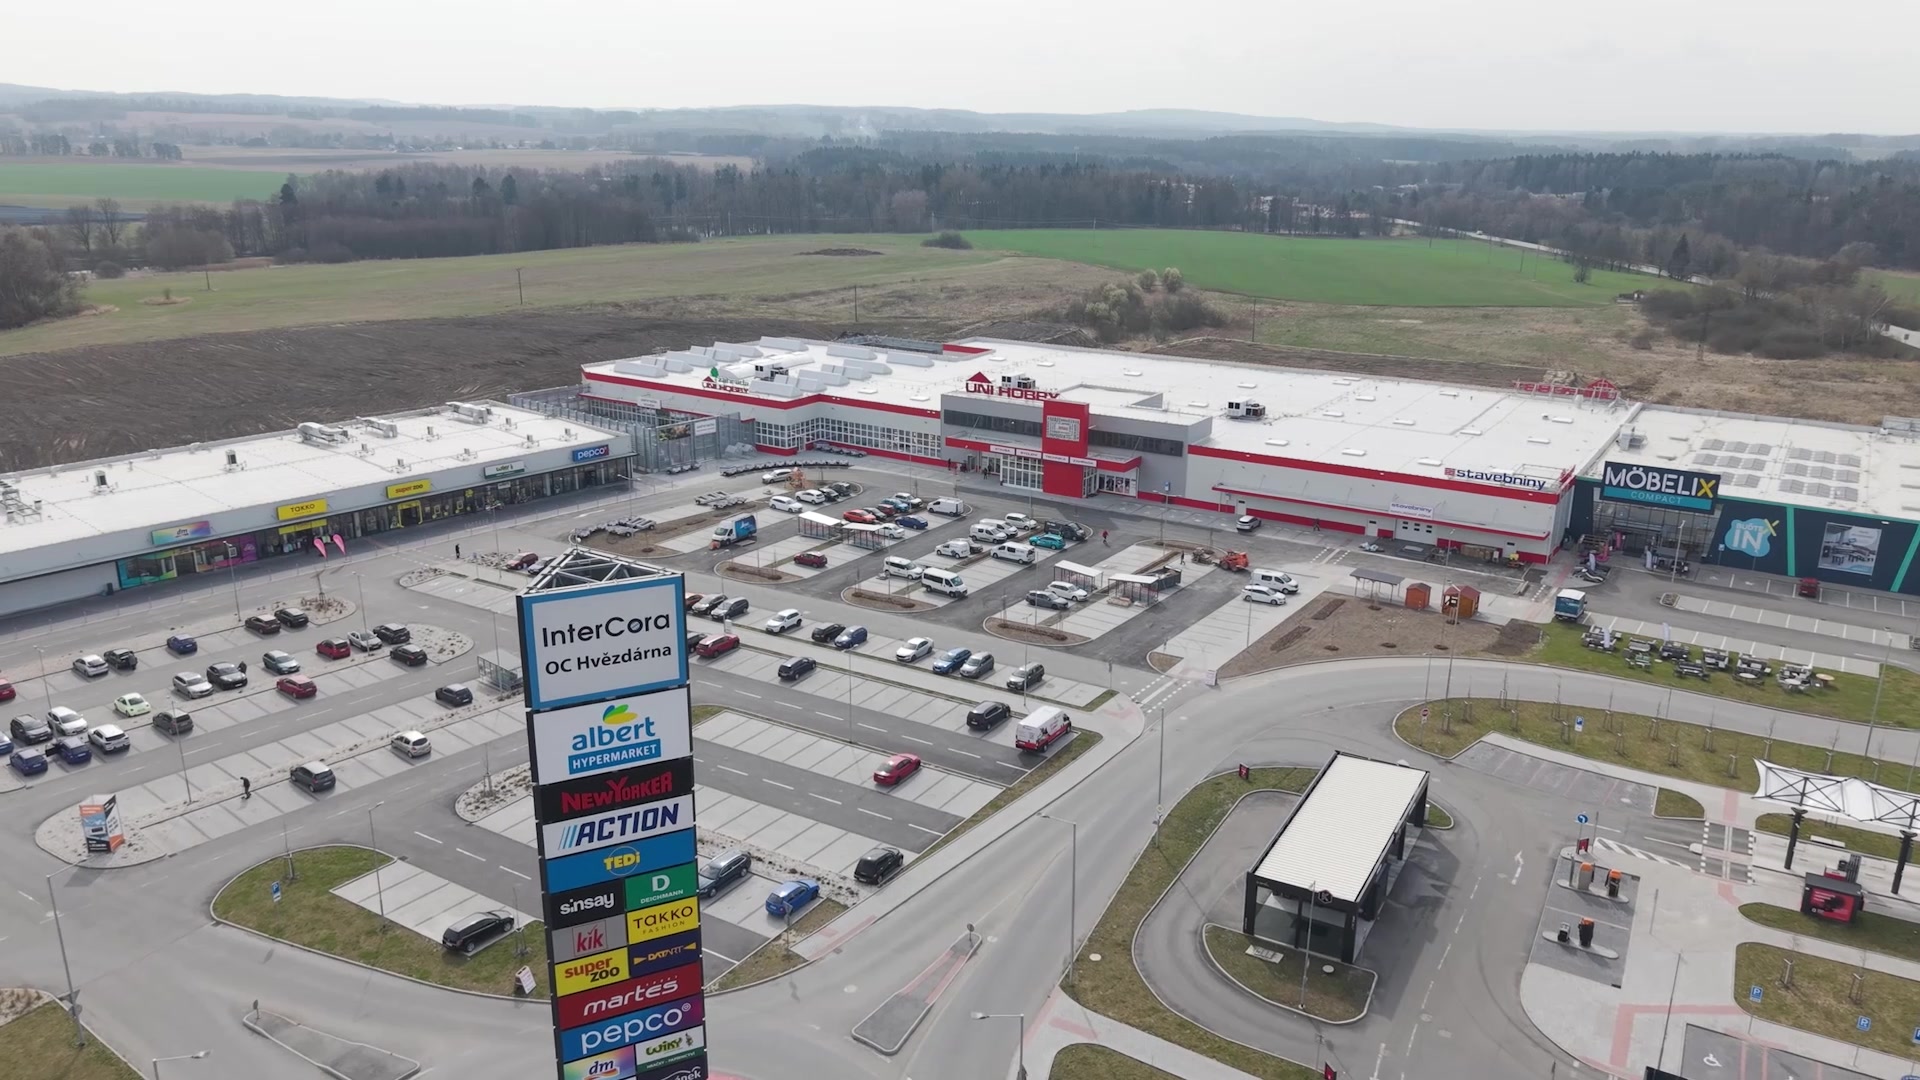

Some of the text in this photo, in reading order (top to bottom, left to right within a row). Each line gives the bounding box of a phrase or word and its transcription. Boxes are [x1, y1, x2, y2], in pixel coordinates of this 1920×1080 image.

[965, 382, 1060, 400] UNI HOBBY
[578, 448, 605, 460] pepco
[1456, 468, 1546, 490] stavebniny
[1604, 466, 1716, 498] MÖBELIX
[1630, 491, 1682, 504] COMPACT
[1732, 529, 1763, 550] IN
[542, 614, 670, 647] InterCora
[545, 646, 672, 675] OC Hvězdárna
[572, 716, 656, 751] albert
[572, 744, 657, 770] HYPERMARKET
[575, 803, 680, 846] ACTION
[652, 874, 671, 892] D
[560, 893, 615, 915] sinsay
[640, 889, 684, 904] DEICHMANN
[642, 920, 685, 935] FASHION
[564, 957, 613, 978] super
[590, 966, 620, 983] zoo
[589, 1060, 614, 1075] dm
